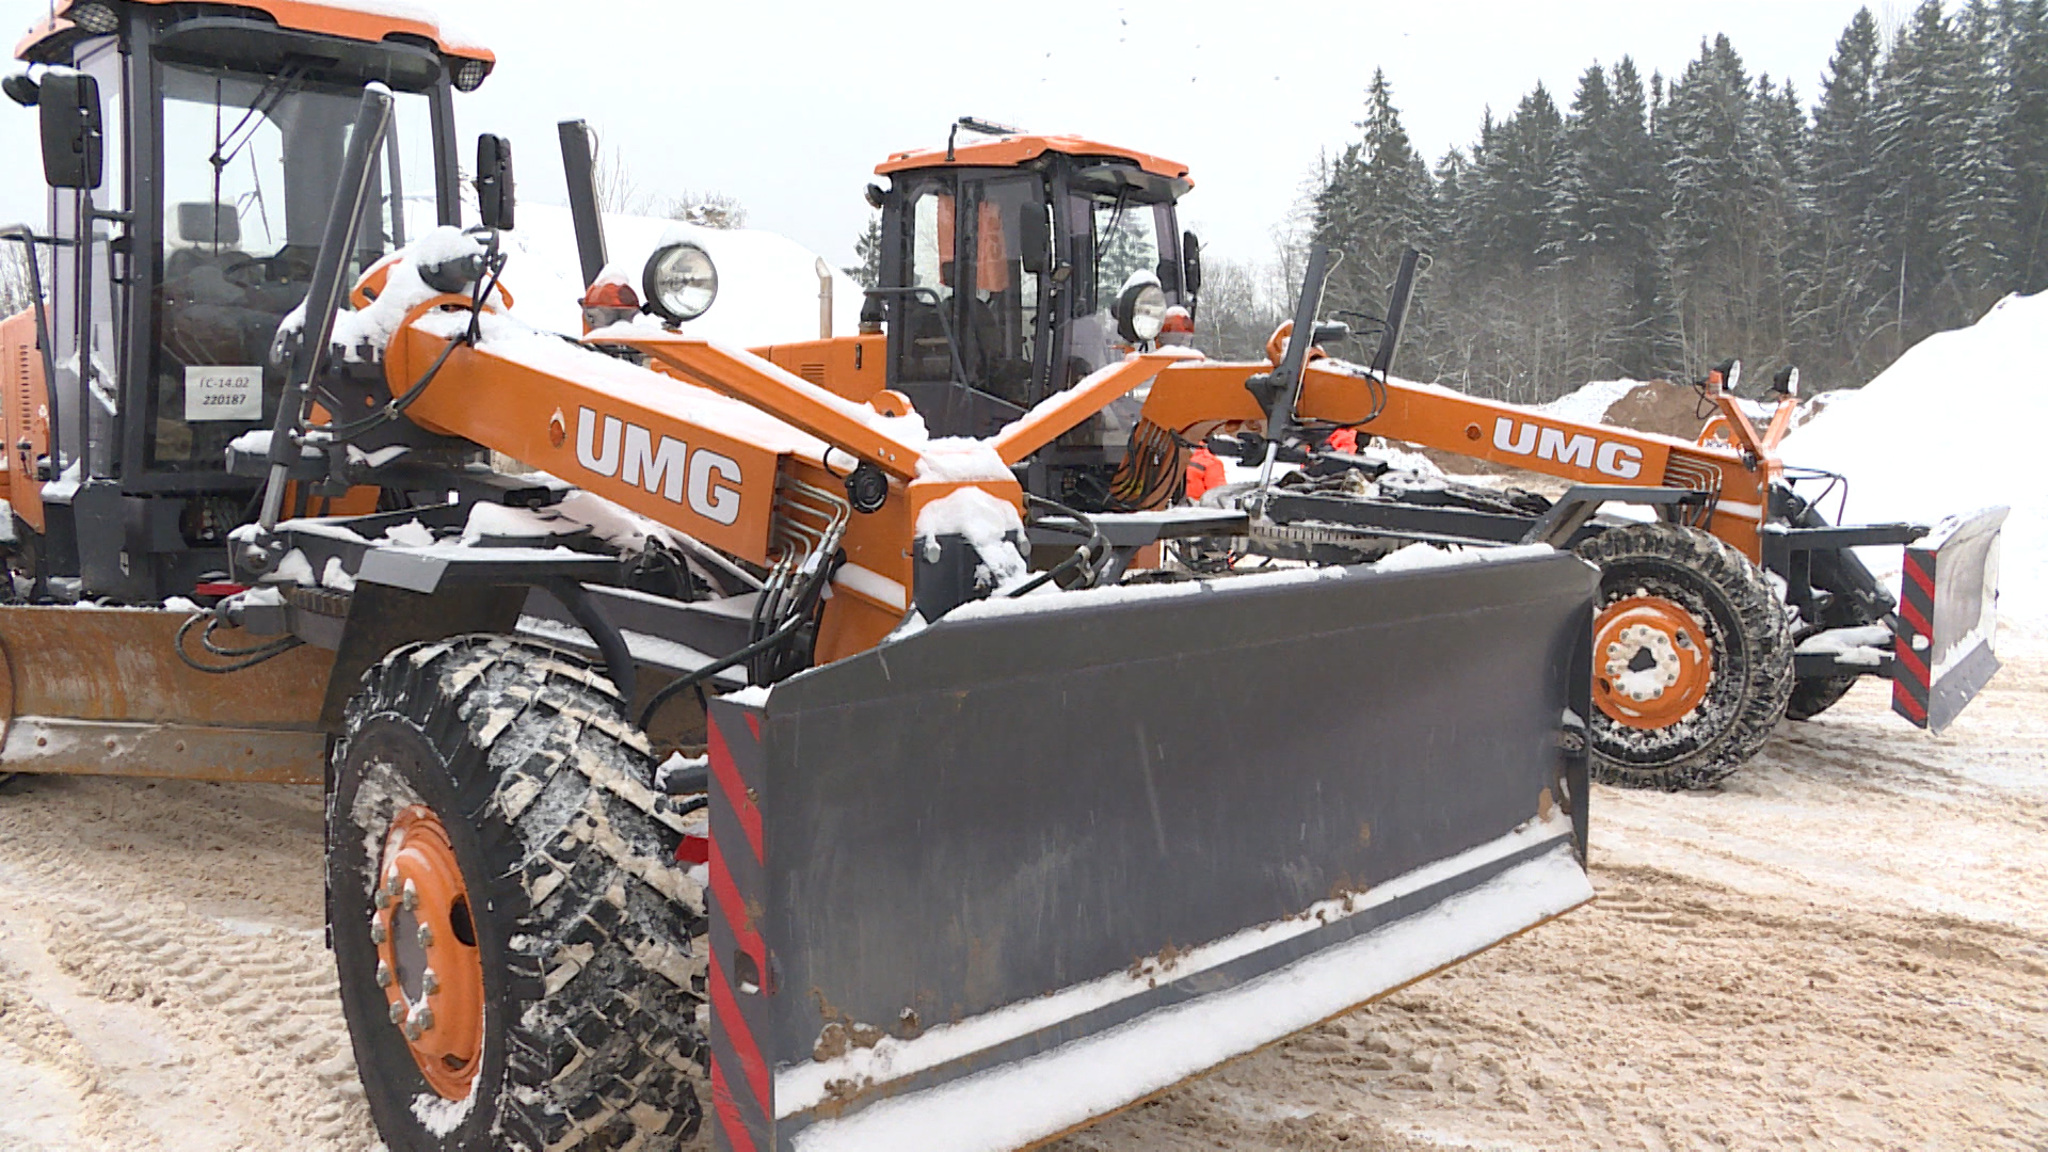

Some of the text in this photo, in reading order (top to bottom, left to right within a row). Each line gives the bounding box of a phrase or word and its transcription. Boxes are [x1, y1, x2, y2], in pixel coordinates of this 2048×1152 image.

[202, 394, 247, 406] 220187
[576, 404, 743, 527] UMG
[1492, 416, 1644, 479] UMG
